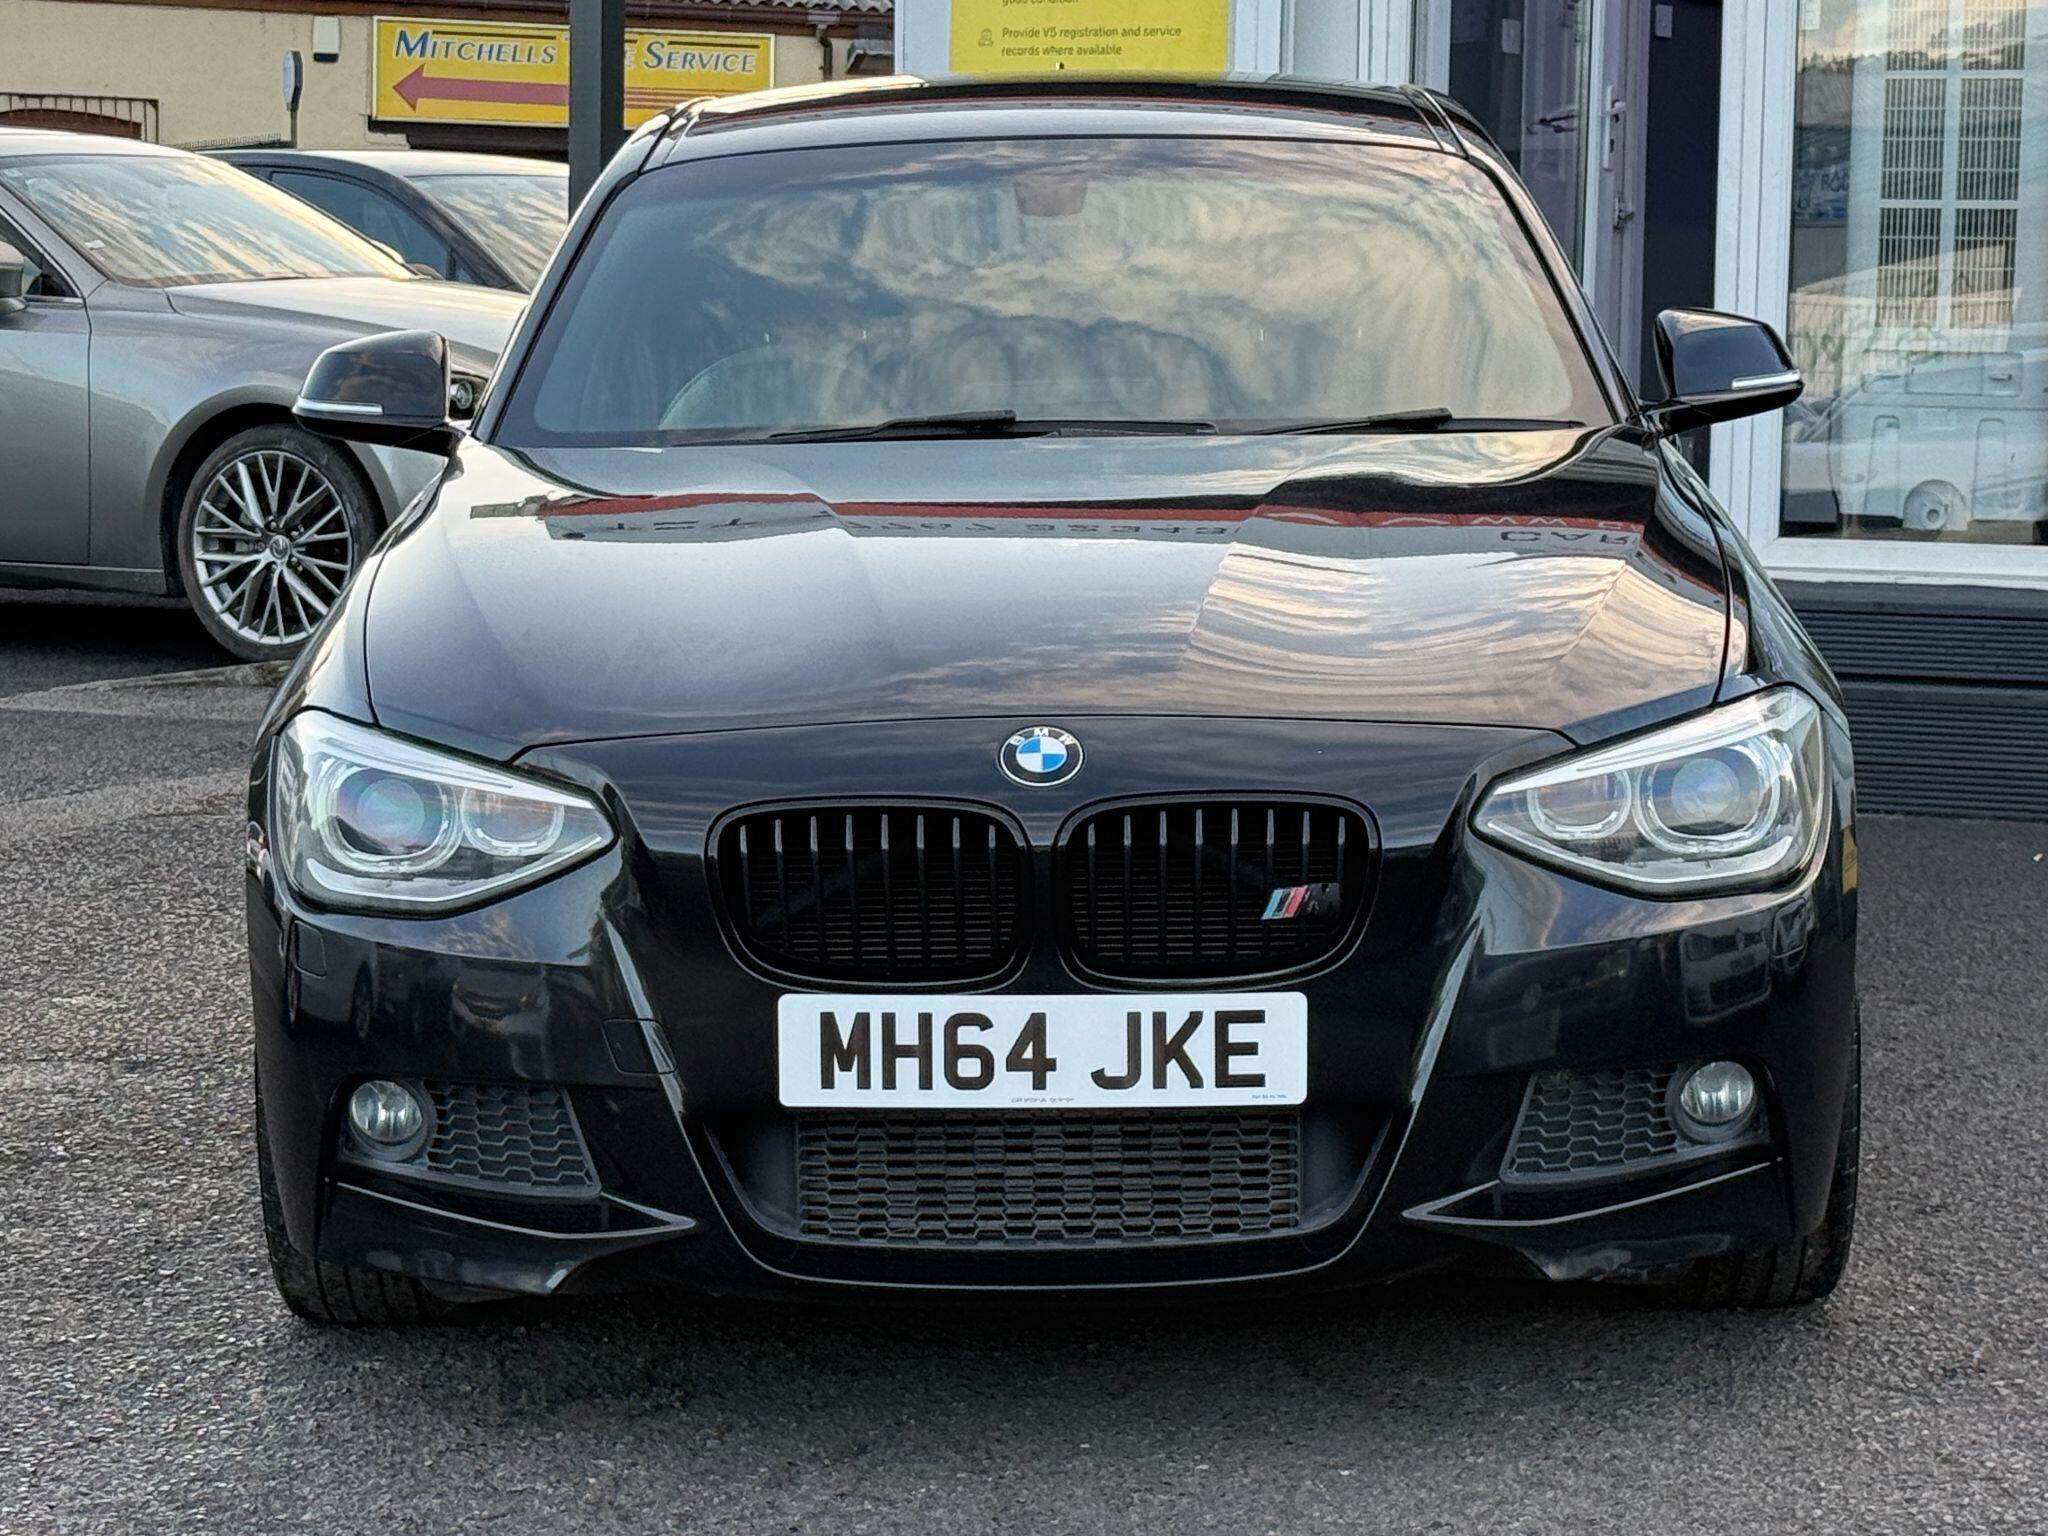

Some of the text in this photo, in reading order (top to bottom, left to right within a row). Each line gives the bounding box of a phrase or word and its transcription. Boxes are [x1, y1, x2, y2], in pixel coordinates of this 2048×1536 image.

[1002, 25, 1182, 40] Provide V5 registration and service
[395, 29, 557, 65] MITCHELLS
[644, 40, 756, 73] SERVICE
[1002, 44, 1122, 56] records where available
[1008, 727, 1077, 746] BMW
[819, 1009, 1267, 1091] MH64 JKE
